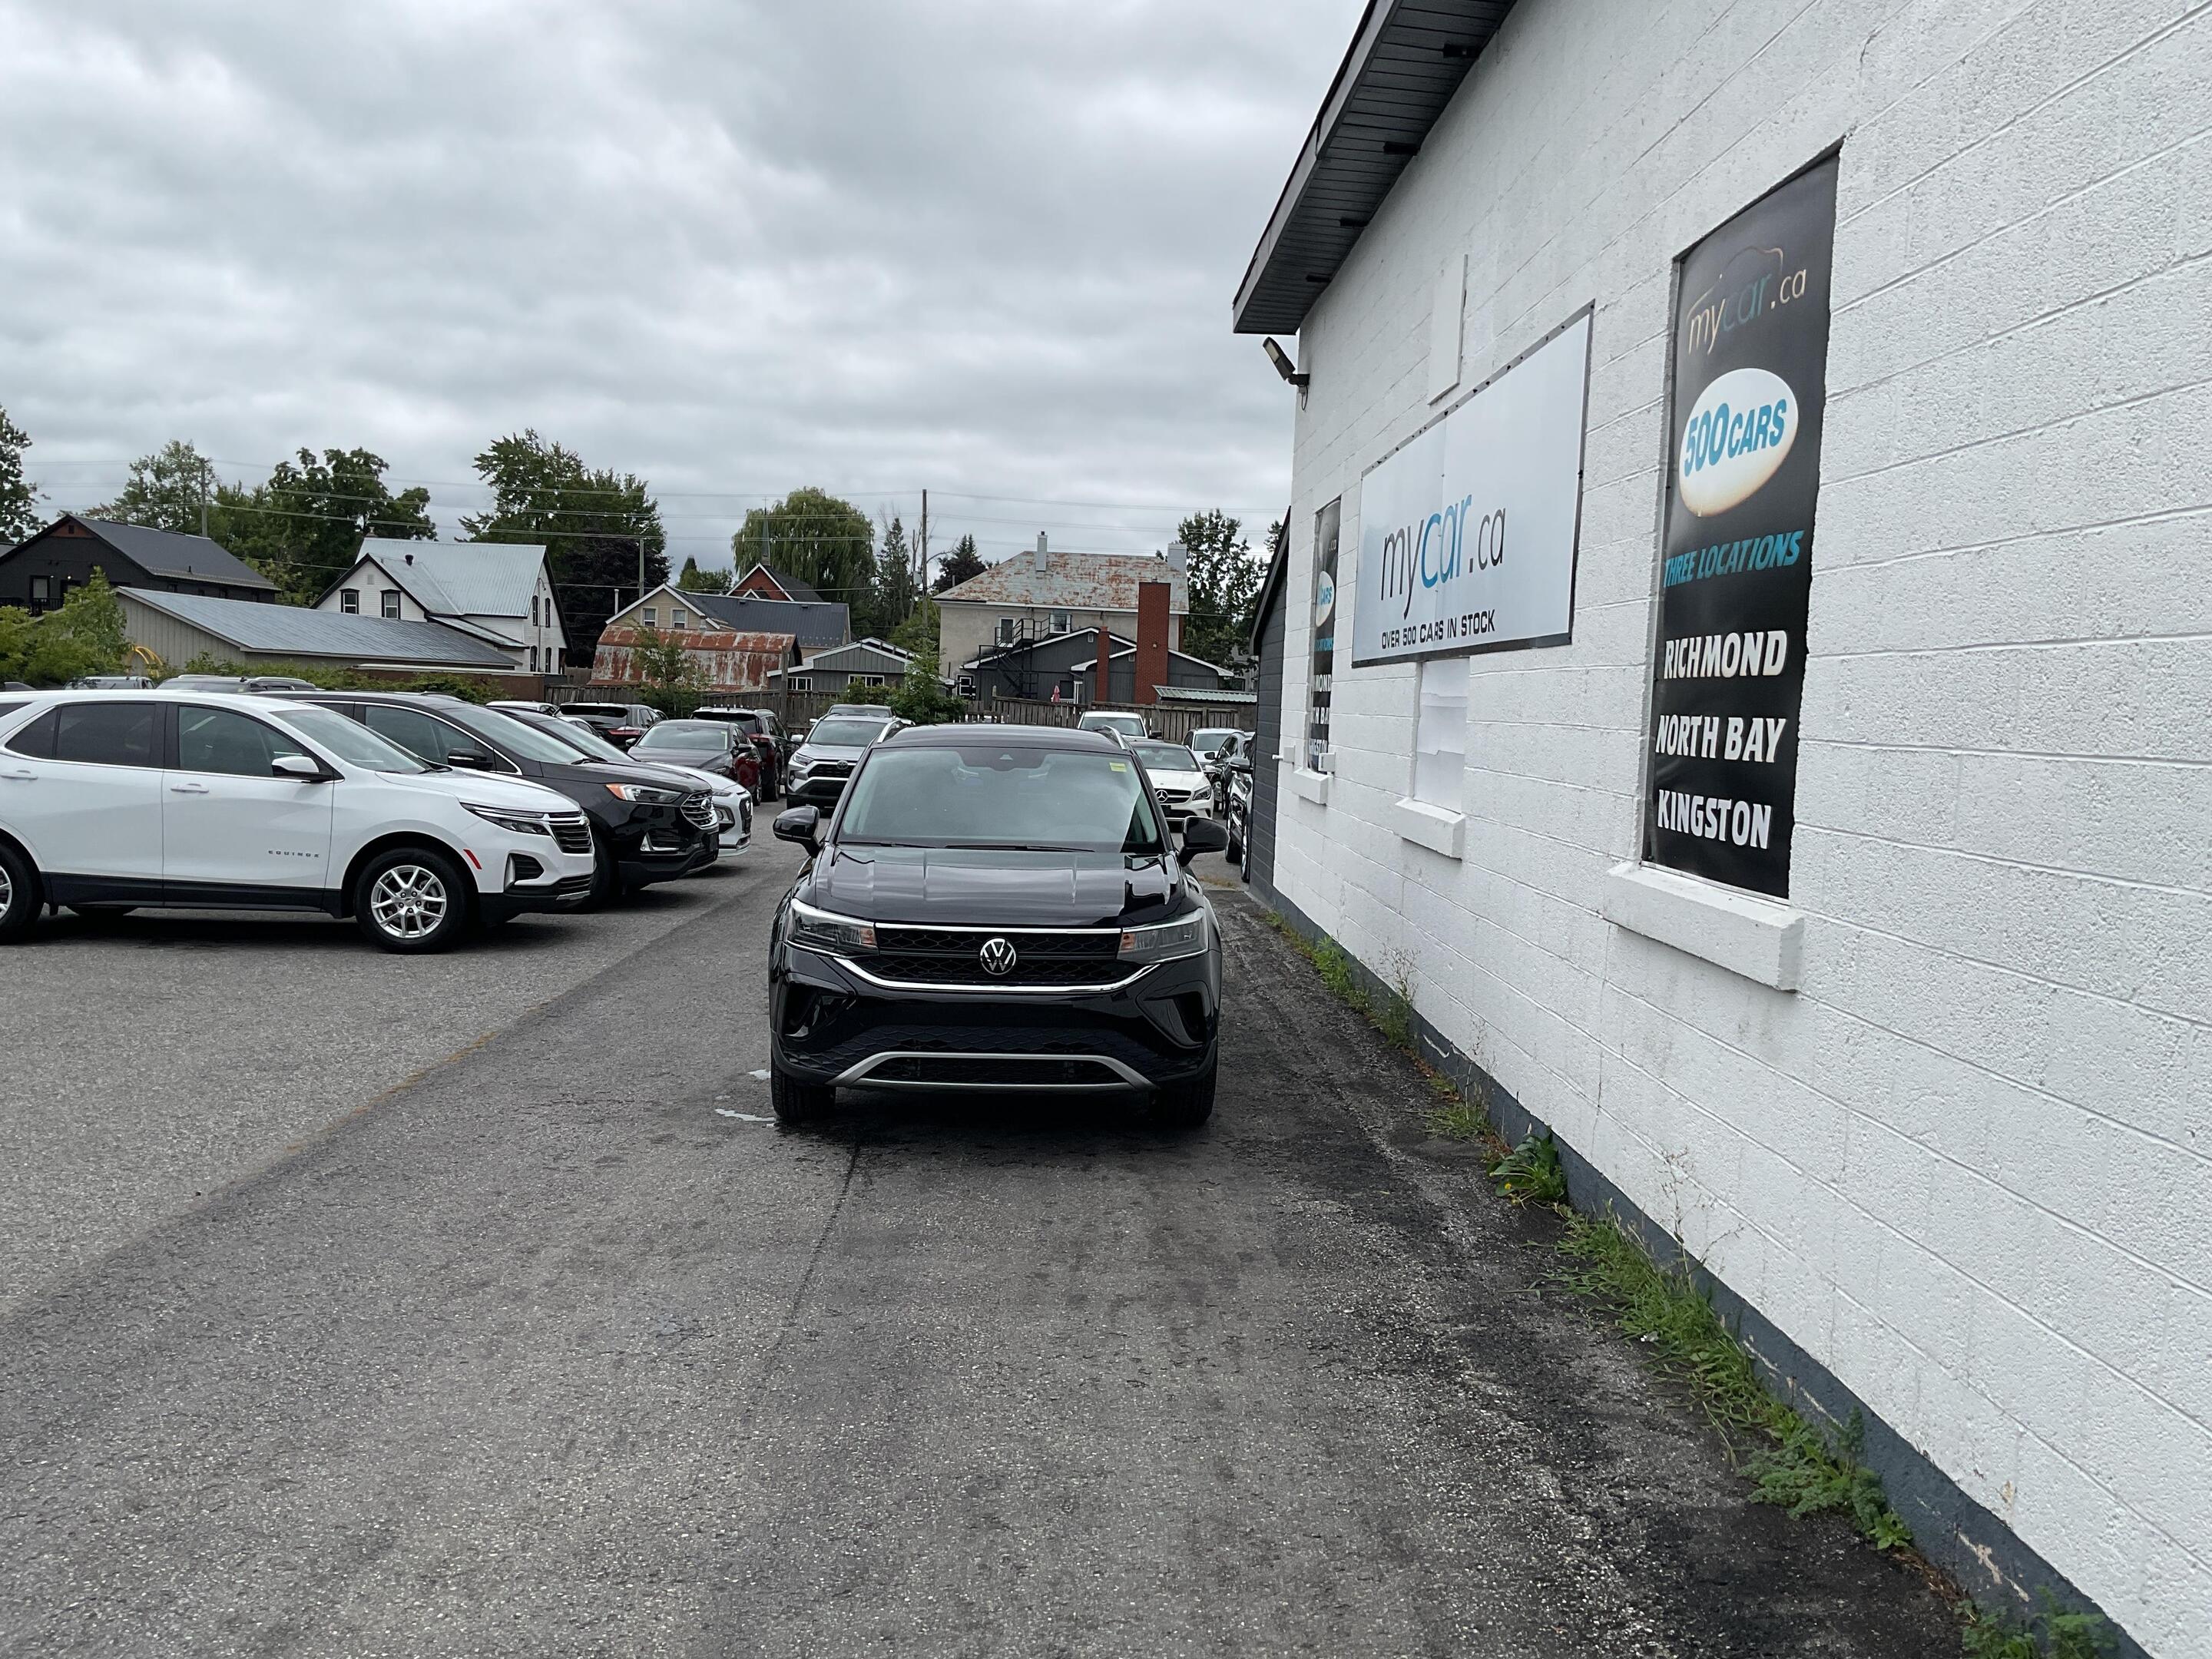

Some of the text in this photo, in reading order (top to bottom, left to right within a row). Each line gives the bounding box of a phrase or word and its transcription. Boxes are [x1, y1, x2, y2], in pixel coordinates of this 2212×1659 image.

[1688, 267, 1807, 355] mycar.ca
[1380, 494, 1506, 621] mycar.ca
[1663, 530, 1806, 588] THREE LOCATIONS
[1382, 609, 1495, 650] OVER 500 CARS IN STOCK
[1663, 630, 1788, 680] RICHMOND
[1654, 714, 1787, 763] NORTH BAY
[1657, 789, 1773, 850] KINGSTON
